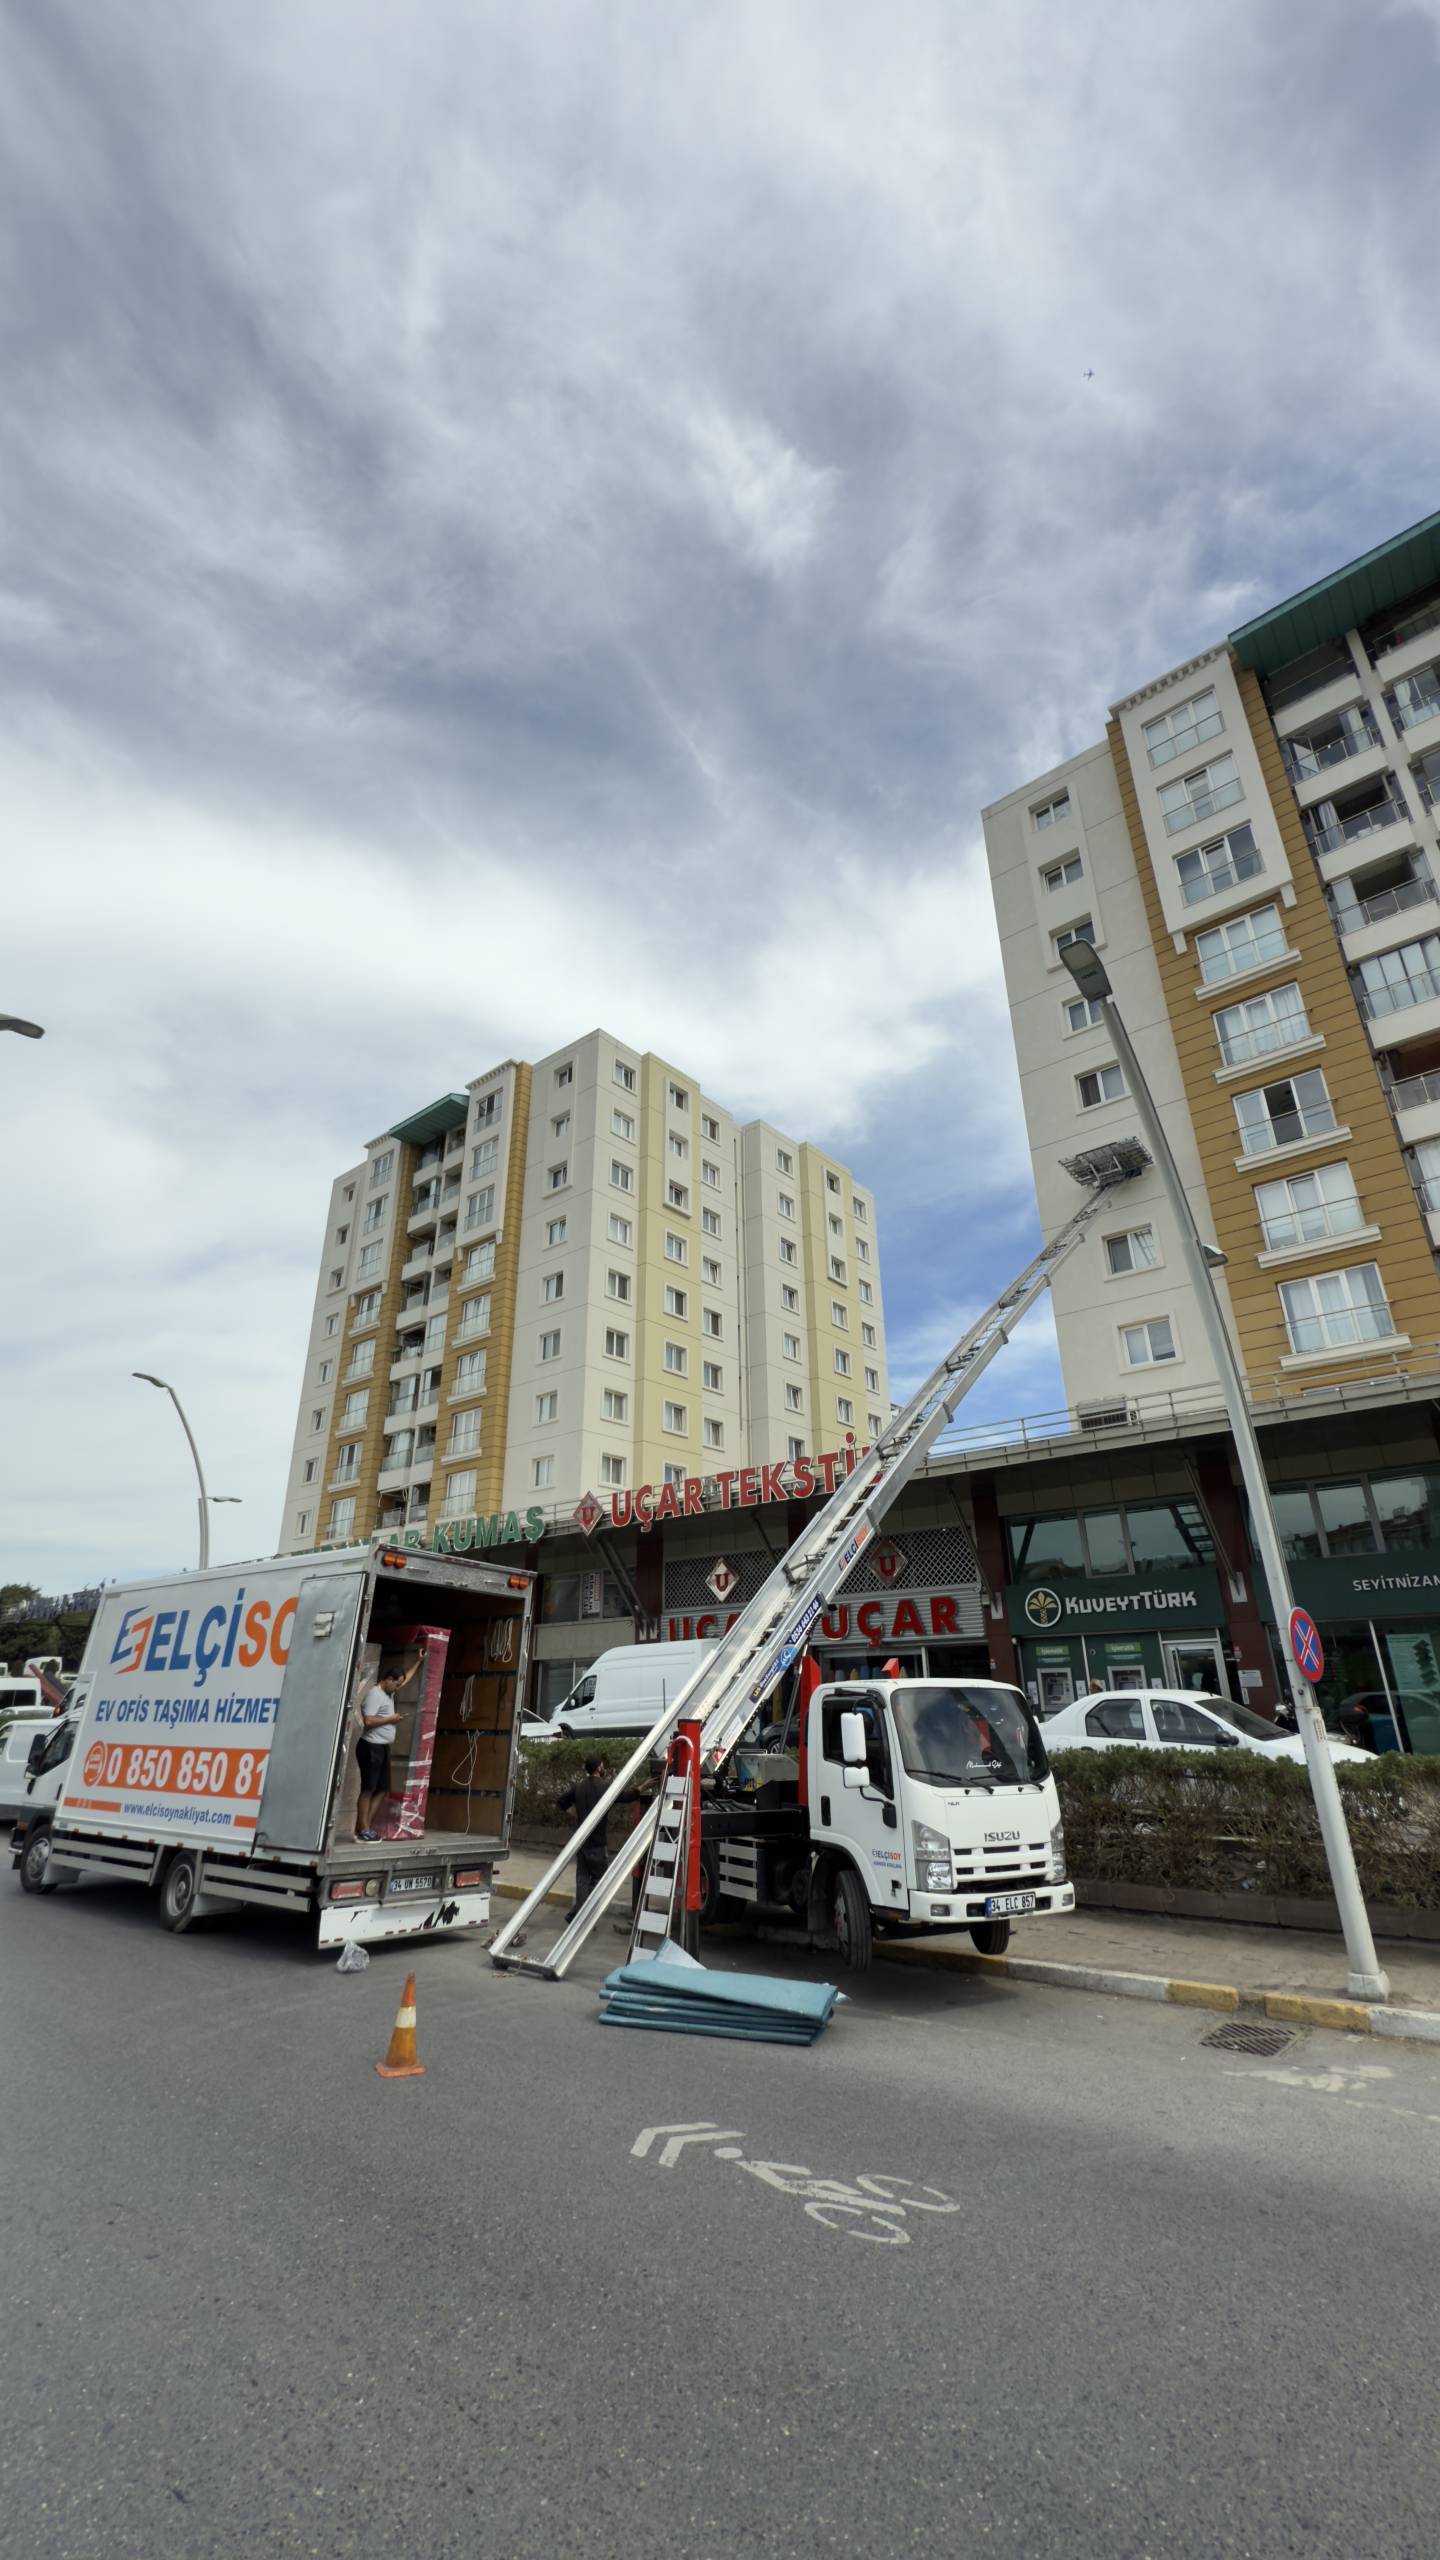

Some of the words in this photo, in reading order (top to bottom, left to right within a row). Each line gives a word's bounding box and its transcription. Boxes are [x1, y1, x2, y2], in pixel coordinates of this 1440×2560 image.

[611, 1478, 705, 1532] UÇAR
[716, 1432, 878, 1510] TEKSTİ
[431, 1506, 545, 1553] KUMAŞ
[821, 1597, 960, 1648] UÇAR
[95, 1700, 116, 1722] EV
[116, 1695, 150, 1723] OFİS
[153, 1699, 209, 1730] TAŞIMA
[106, 1747, 123, 1784] 0
[126, 1748, 172, 1789] 850
[177, 1750, 228, 1793] 850
[123, 1802, 232, 1825] www.elcisoynakliyat.com
[984, 1831, 1021, 1842] ISUZU
[991, 1899, 1001, 1912] 34
[1005, 1897, 1019, 1911] ELC
[1021, 1894, 1034, 1908] 857
